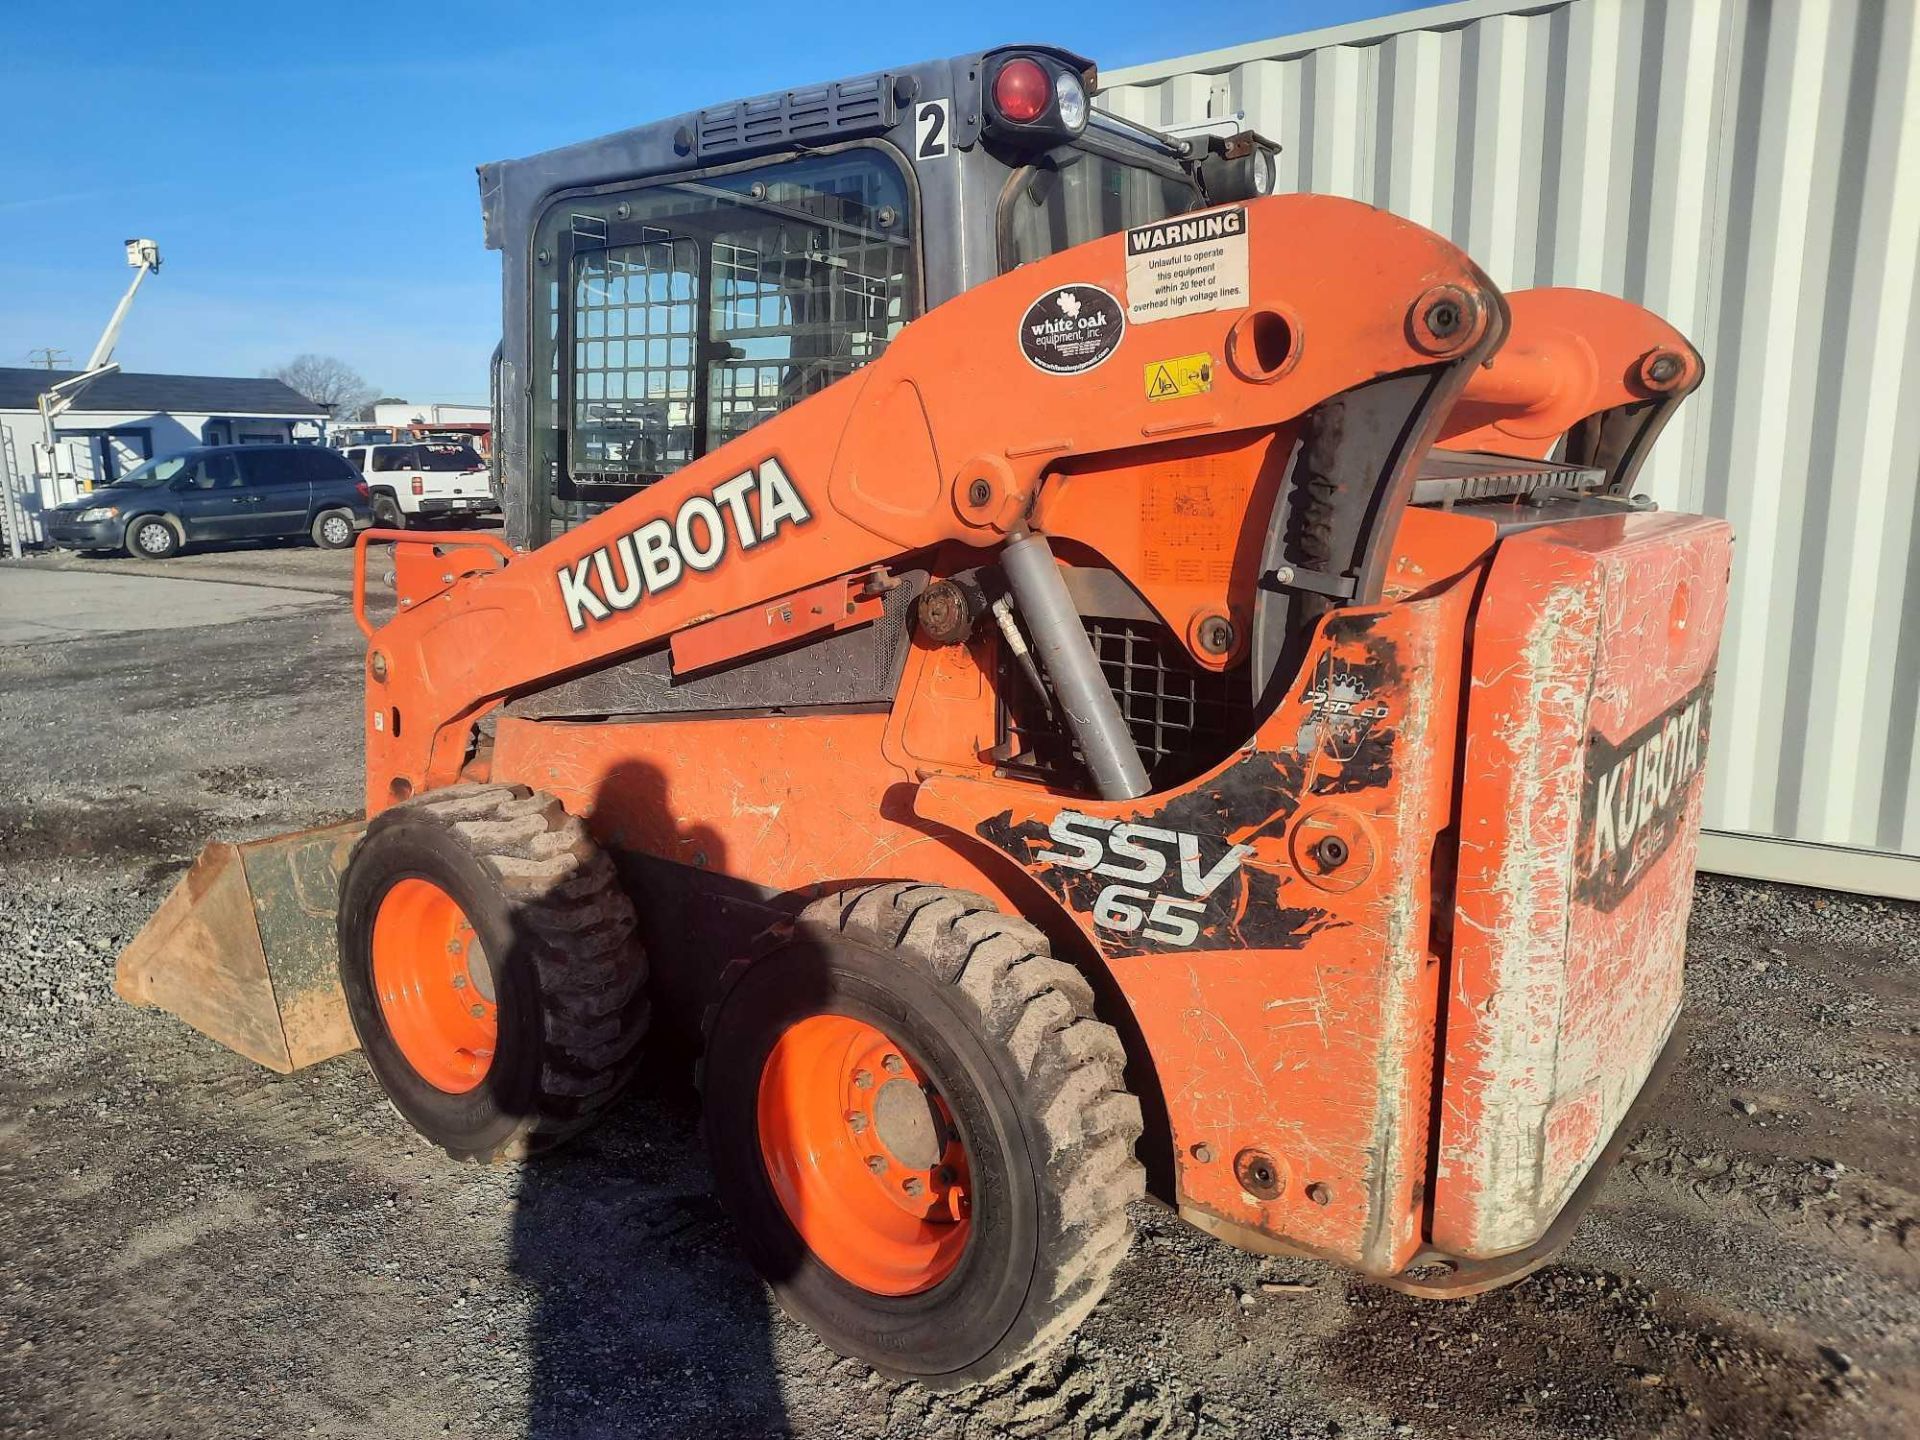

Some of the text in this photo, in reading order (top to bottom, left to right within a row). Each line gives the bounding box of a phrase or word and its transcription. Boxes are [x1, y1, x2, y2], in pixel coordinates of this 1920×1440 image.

[919, 103, 945, 158] 2
[1132, 213, 1240, 251] WARNING
[1148, 248, 1224, 270] Unlawful to operate
[1157, 263, 1215, 281] this equipment
[1133, 286, 1242, 312] overhead high voltage lines.
[1155, 276, 1216, 295] within 20 feet of
[1031, 311, 1107, 336] white oak
[1086, 327, 1103, 339] inc.
[557, 457, 811, 632] KUBOTA
[1590, 699, 1701, 876] KUBOTA
[1036, 810, 1257, 896] SSV
[1092, 884, 1207, 947] 65
